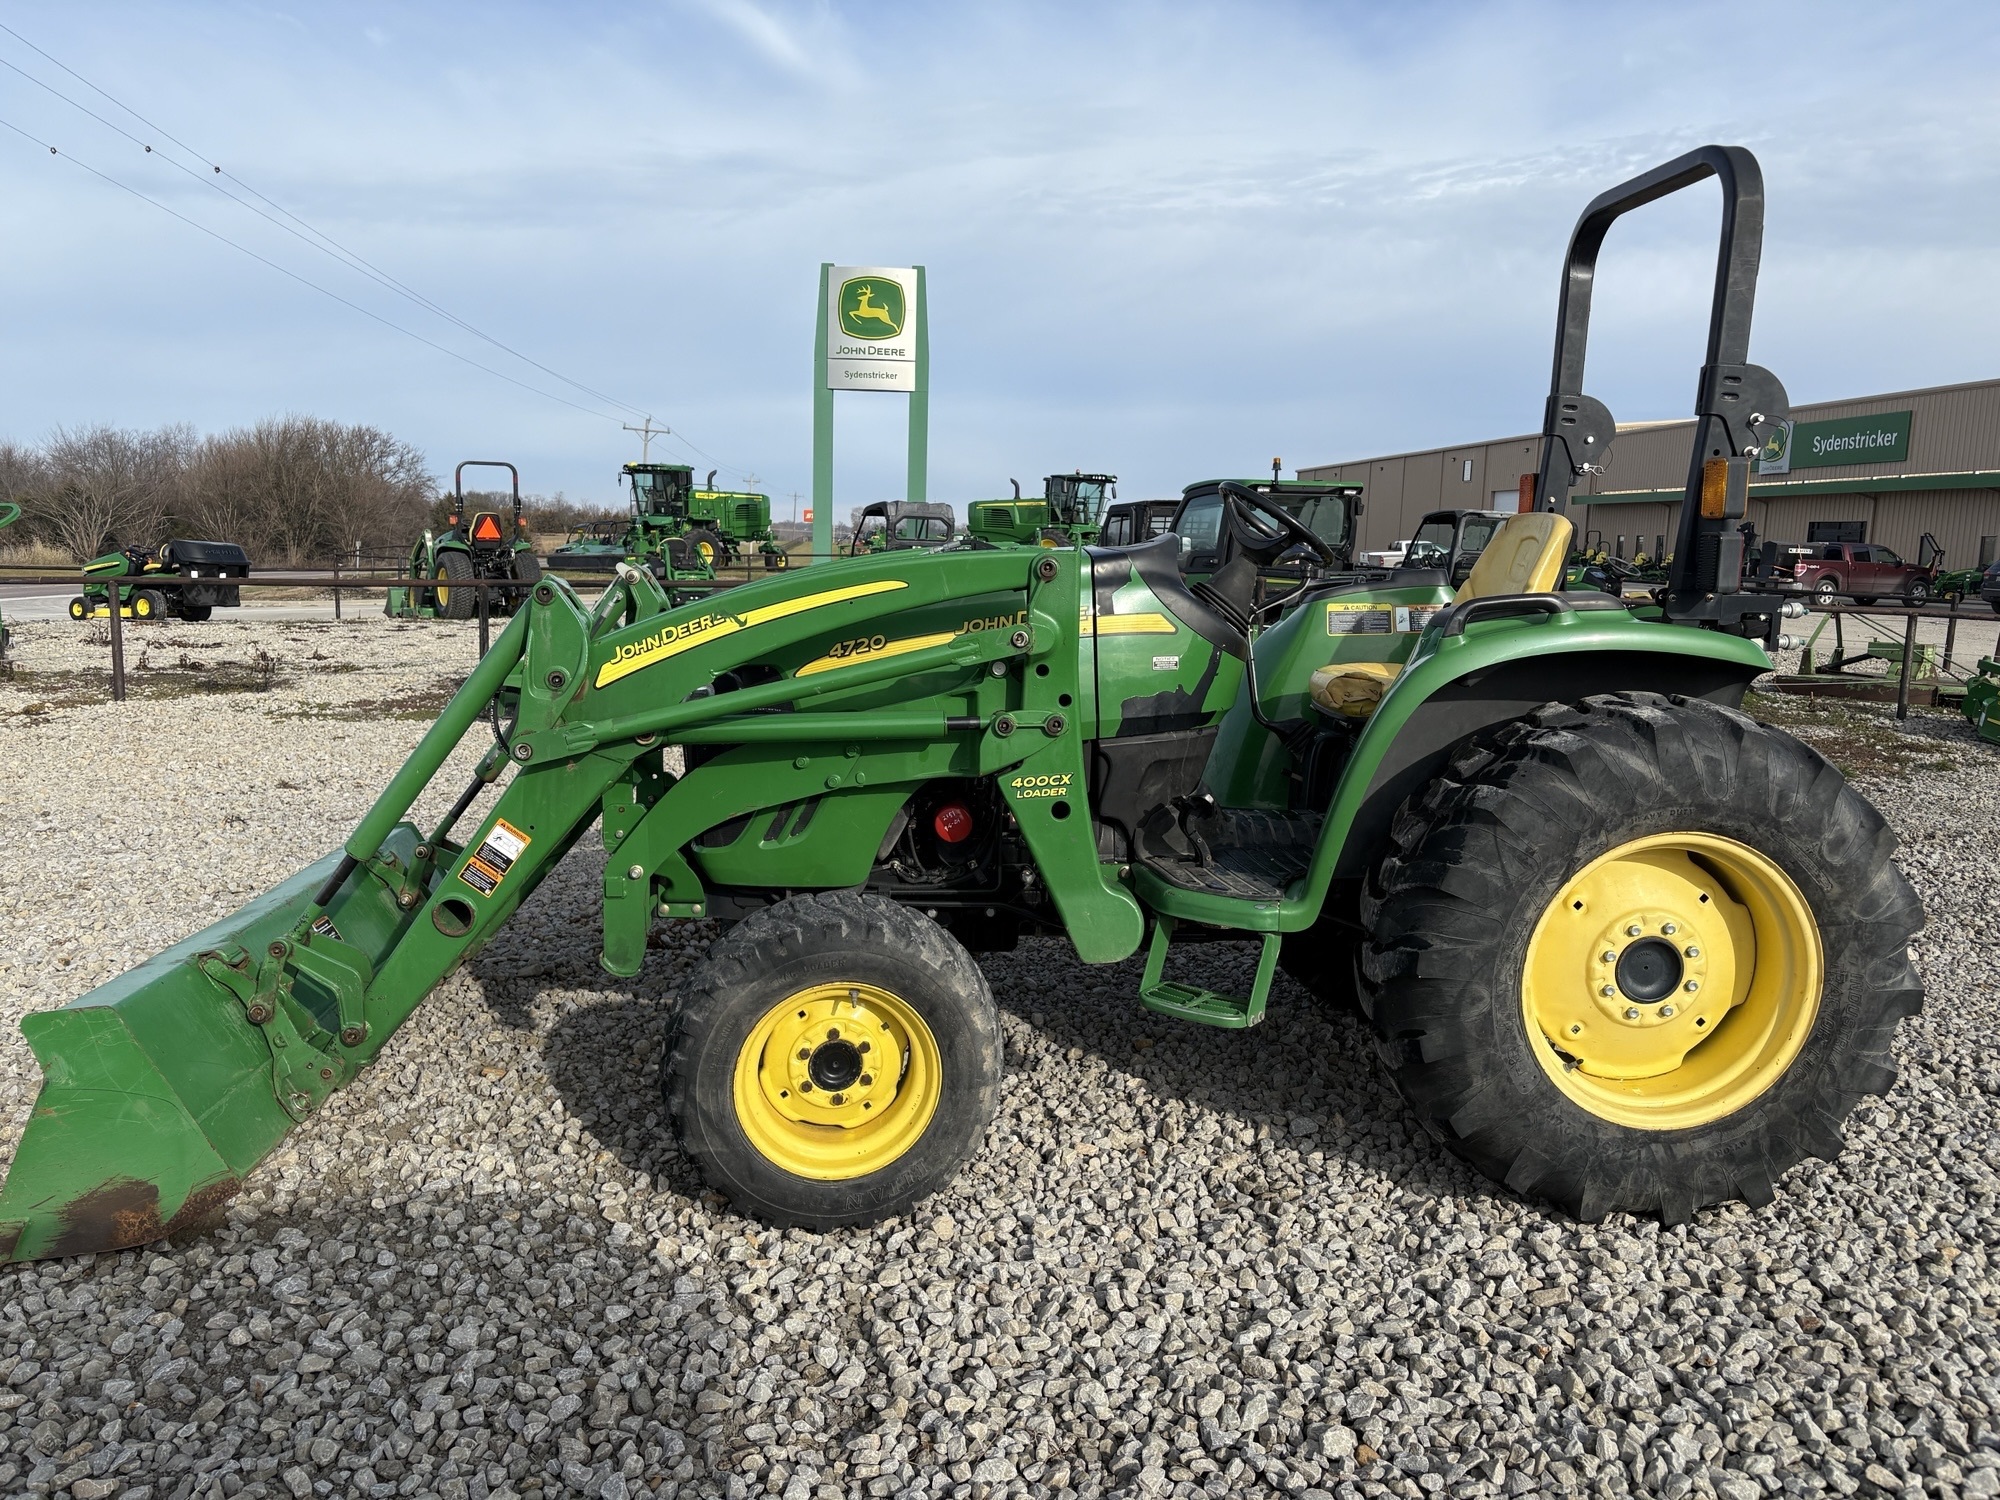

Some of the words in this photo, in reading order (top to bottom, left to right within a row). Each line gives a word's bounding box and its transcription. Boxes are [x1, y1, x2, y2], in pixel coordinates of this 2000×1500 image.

[836, 345, 866, 355] JOHN
[867, 346, 906, 357] DEERE
[844, 370, 898, 380] Sydenstricker
[1812, 430, 1897, 455] Sydenstricker
[954, 615, 1014, 636] JOHN
[610, 635, 660, 664] JOHN
[828, 634, 887, 660] 4720
[1011, 772, 1074, 788] 400CX
[1016, 787, 1068, 799] LOADER
[505, 823, 528, 842] WARNING
[478, 864, 500, 881] WARNING
[1822, 972, 1865, 1075] INDUSTRIAL
[842, 1158, 930, 1212] TITAN
